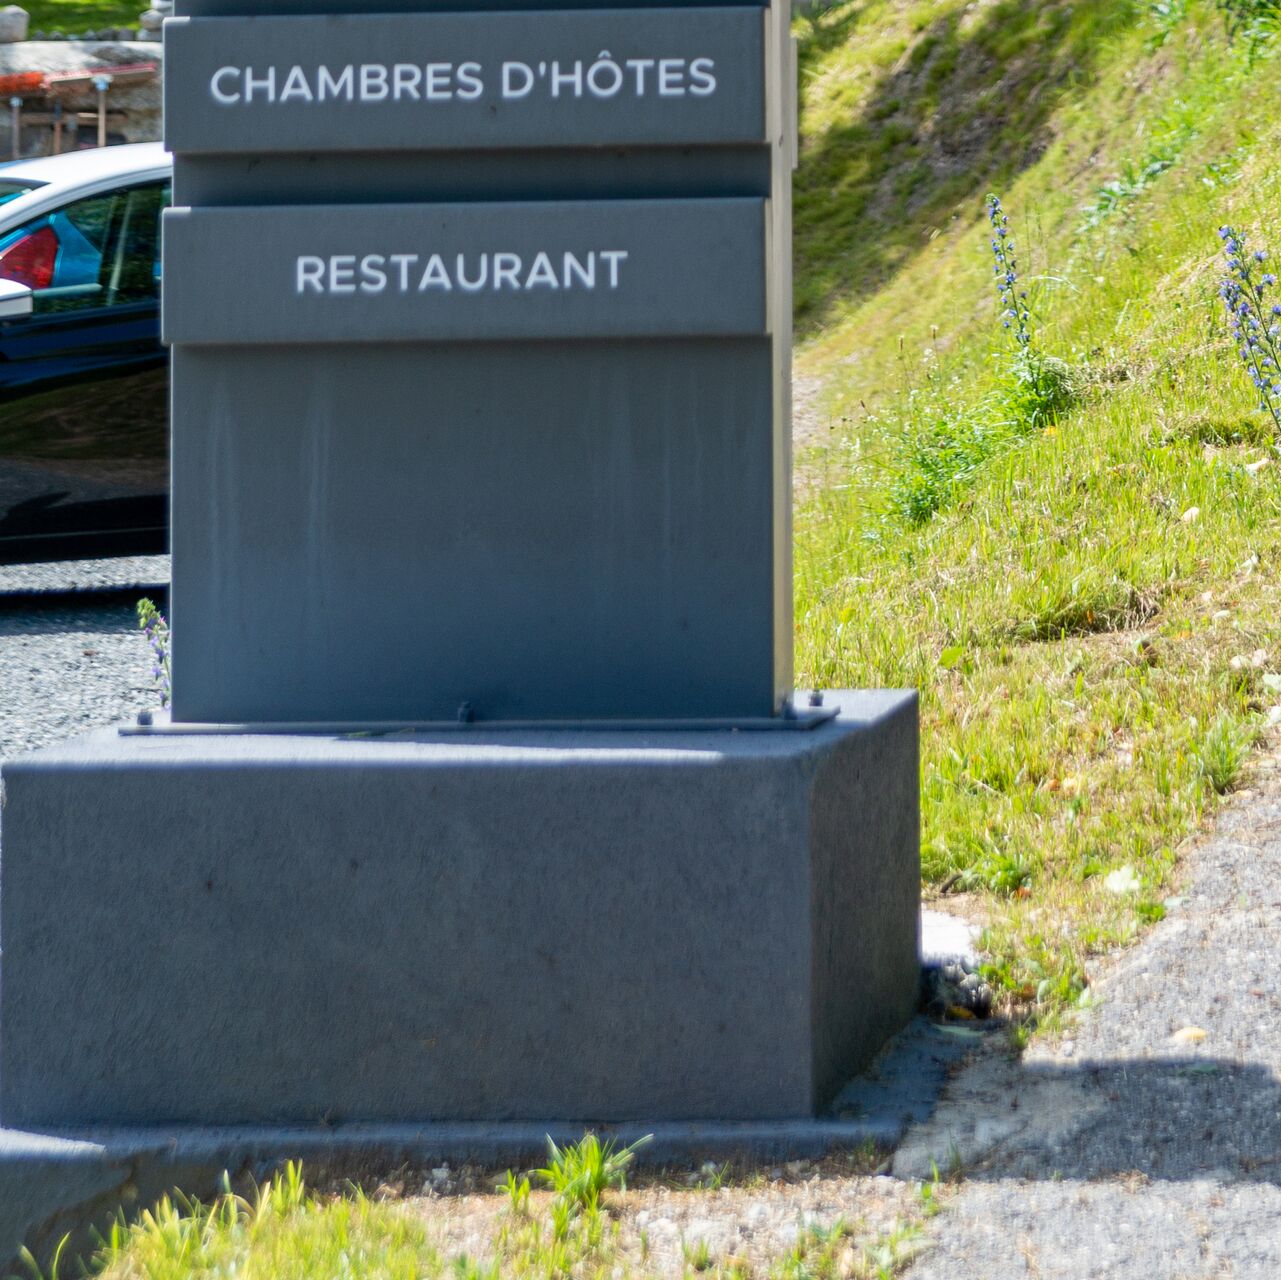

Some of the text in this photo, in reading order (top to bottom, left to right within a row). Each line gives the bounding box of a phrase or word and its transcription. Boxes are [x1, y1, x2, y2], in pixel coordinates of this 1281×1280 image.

[209, 50, 718, 105] CHAMBRES D'HÔTES
[295, 250, 629, 295] RESTAURANT
